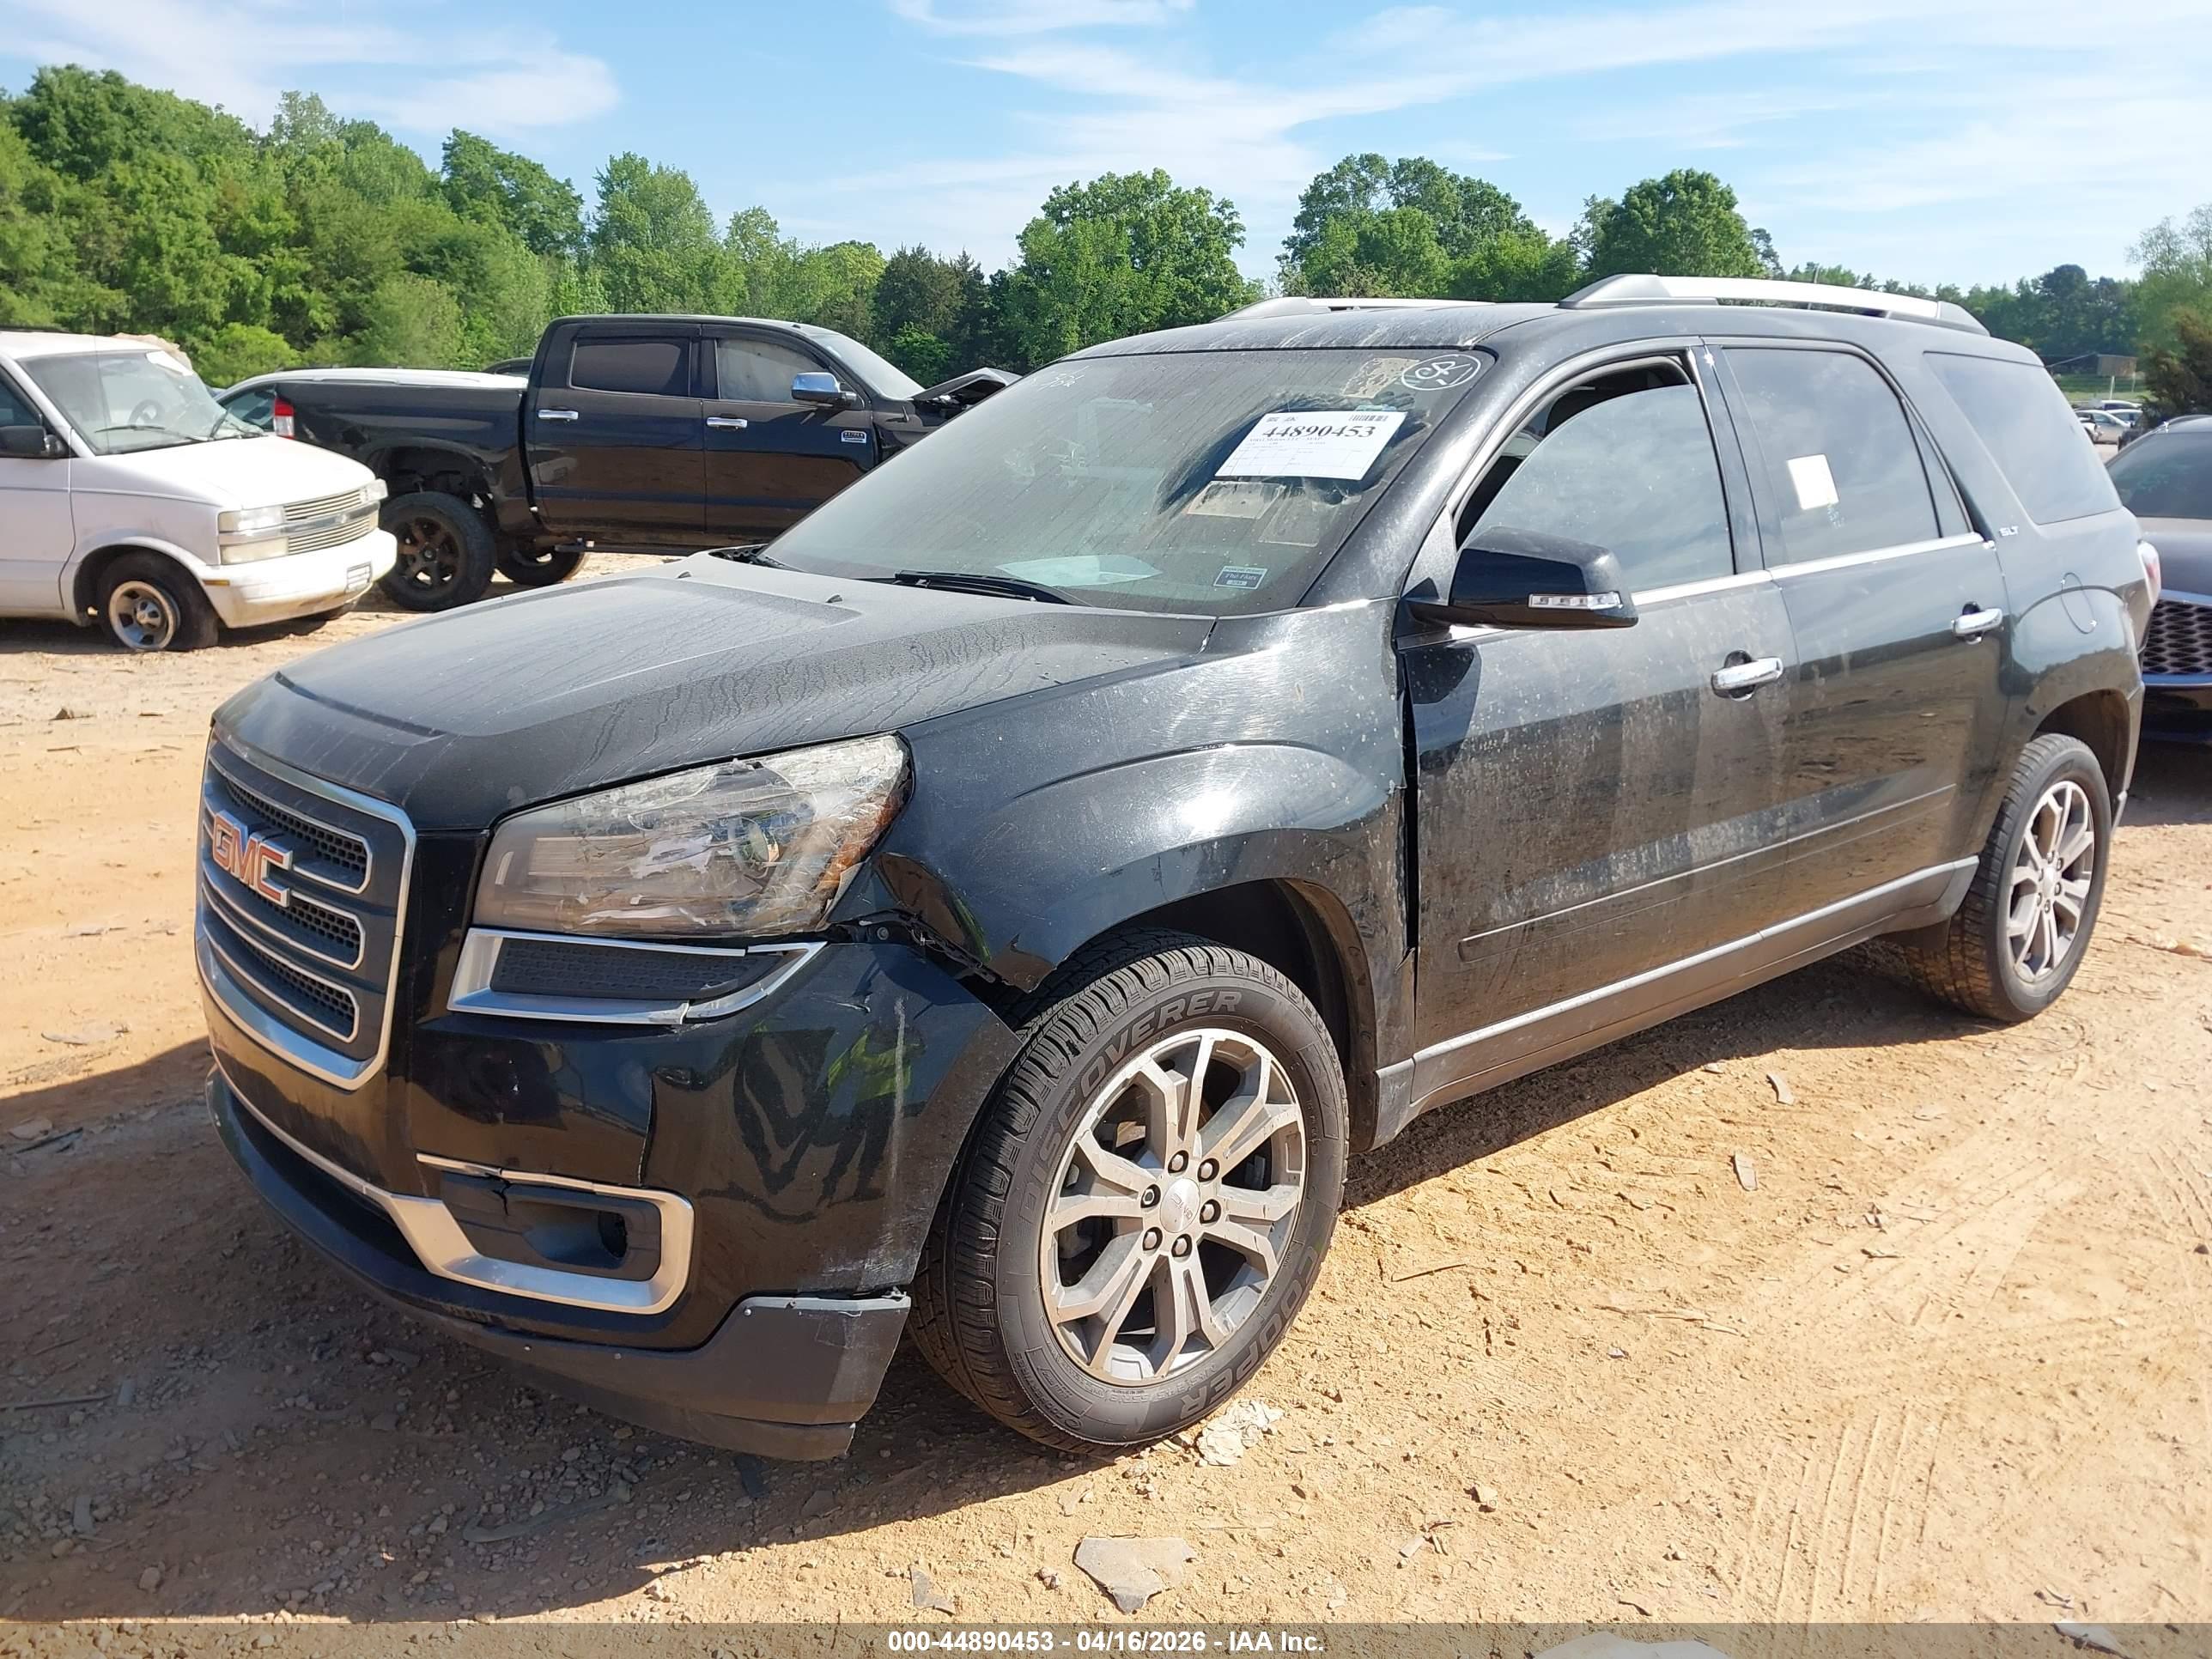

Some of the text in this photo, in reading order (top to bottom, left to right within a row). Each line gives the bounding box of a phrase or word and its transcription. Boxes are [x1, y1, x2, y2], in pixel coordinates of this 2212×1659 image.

[1262, 425, 1377, 437] 44890453
[1999, 526, 2019, 537] SLT
[212, 809, 293, 908] GMC
[1180, 1245, 1320, 1419] COOPER
